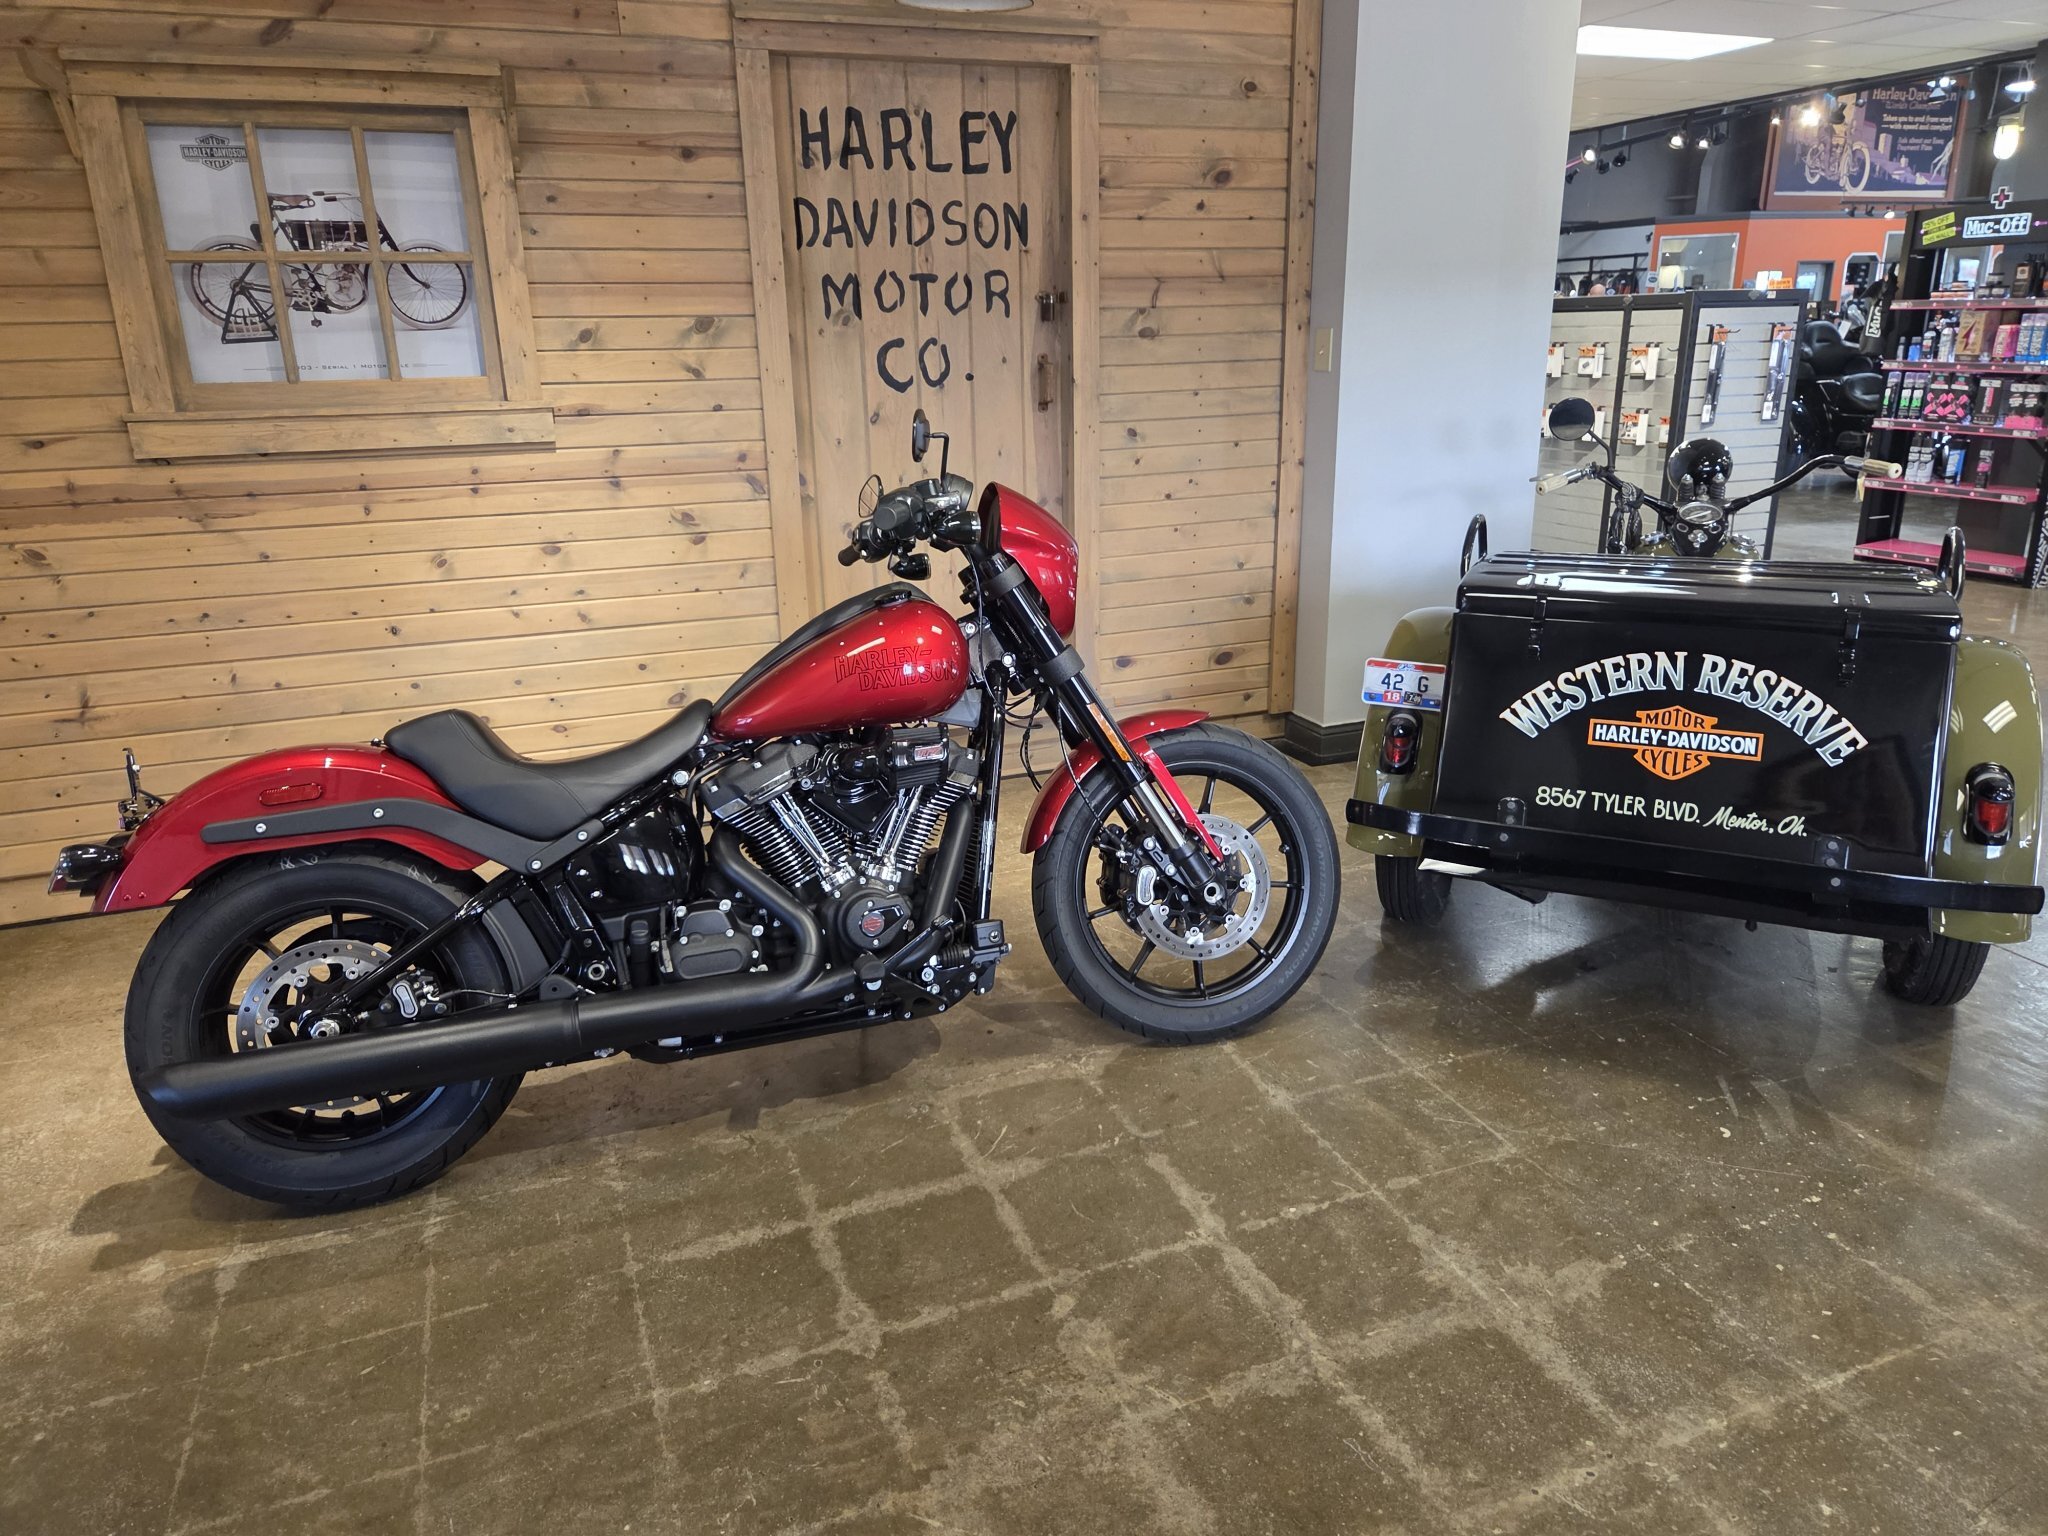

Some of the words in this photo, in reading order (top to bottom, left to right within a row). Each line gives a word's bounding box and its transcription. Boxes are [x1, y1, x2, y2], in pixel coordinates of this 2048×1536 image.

[1872, 87, 1957, 101] Harley-Davn
[182, 146, 246, 158] HARLEY-DAVIDSON
[800, 106, 1017, 175] HARLEY
[793, 196, 1028, 250] DAVIDSON
[1967, 216, 2027, 235] Muc-Off
[822, 269, 1010, 320] MOTOR
[877, 337, 974, 393] CO.
[1381, 672, 1404, 690] 42
[1417, 675, 1430, 693] G
[1499, 651, 1688, 739] WESTERN
[1694, 653, 1869, 768] RESERVE
[1646, 710, 1706, 729] MOTOR
[1594, 724, 1757, 755] HARLEY-DAVIDSON
[1641, 748, 1703, 776] CYCLES
[1535, 786, 1586, 808] 8567
[1591, 791, 1647, 817] TYLER
[1653, 800, 1700, 824] BLVD.
[1703, 806, 1774, 834] Mentor,
